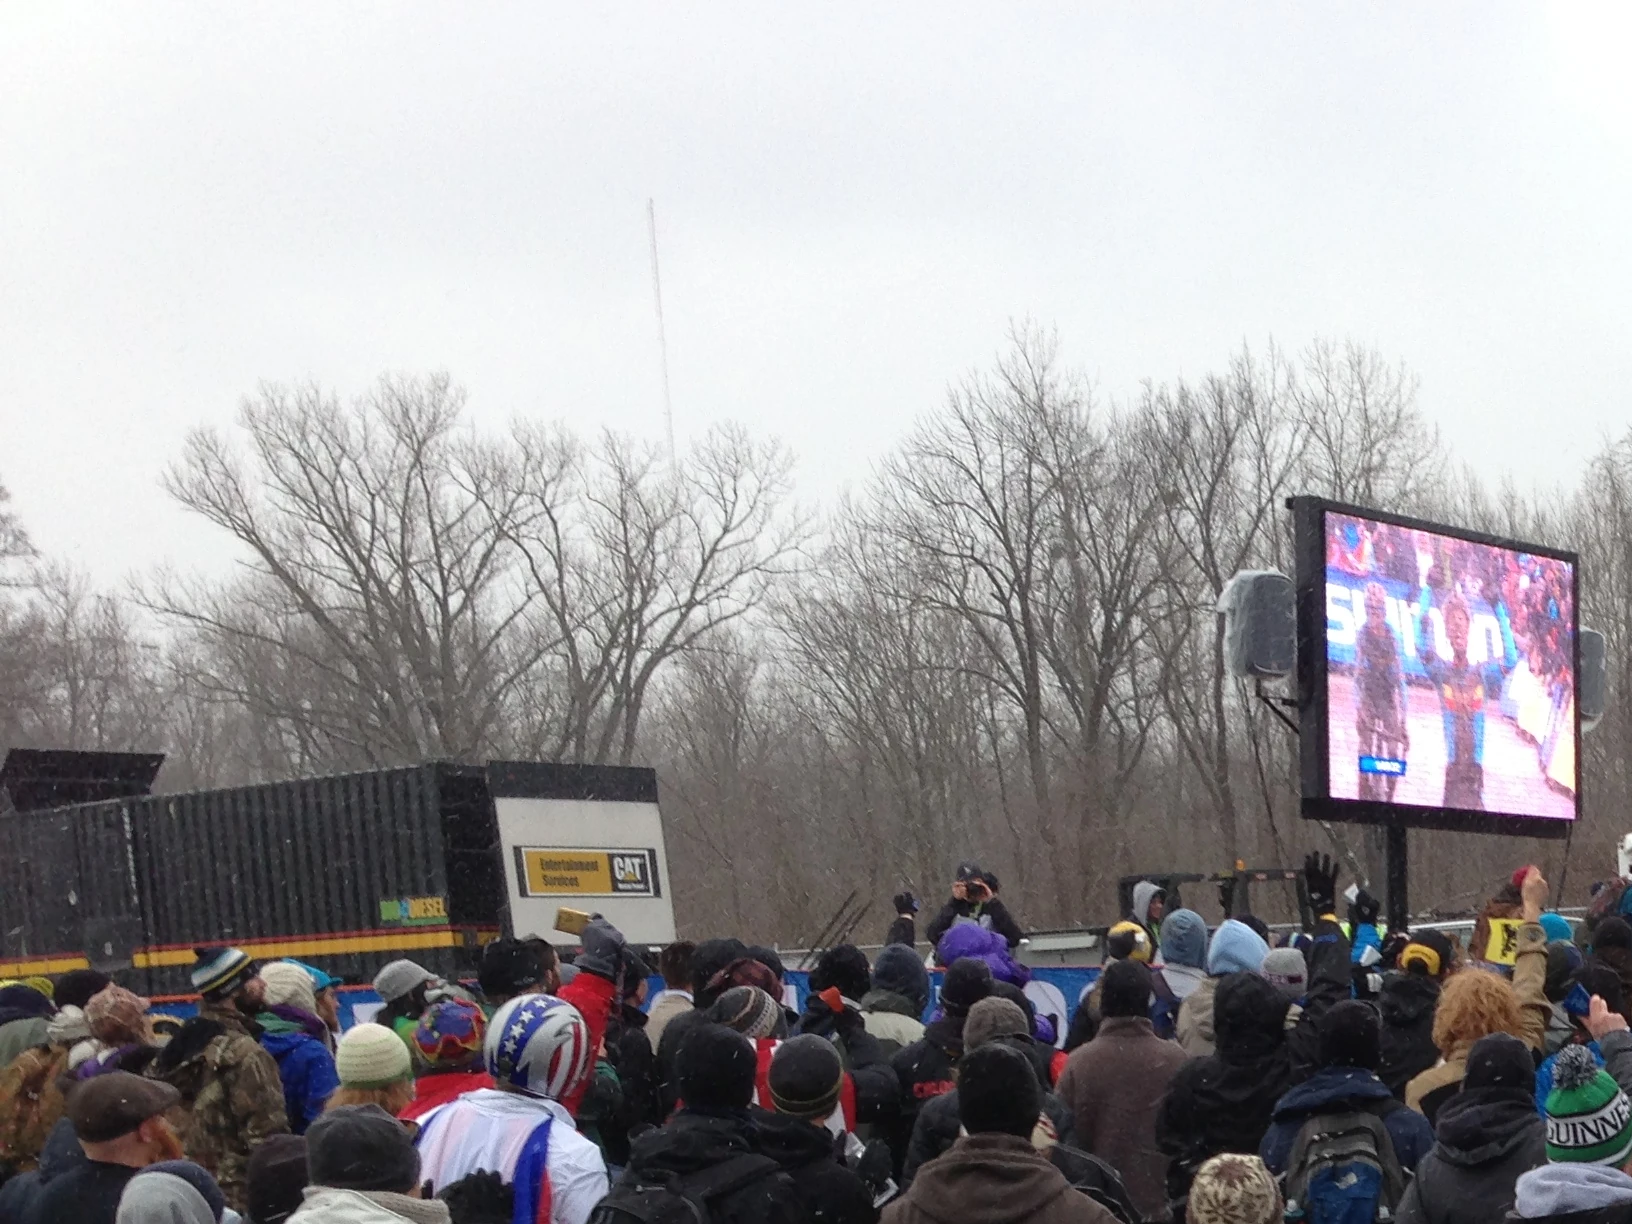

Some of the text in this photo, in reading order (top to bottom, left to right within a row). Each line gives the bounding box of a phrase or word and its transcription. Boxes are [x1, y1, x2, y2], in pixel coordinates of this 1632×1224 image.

[540, 858, 599, 872] Entertainment
[613, 856, 642, 881] CAT
[542, 874, 580, 888] Services
